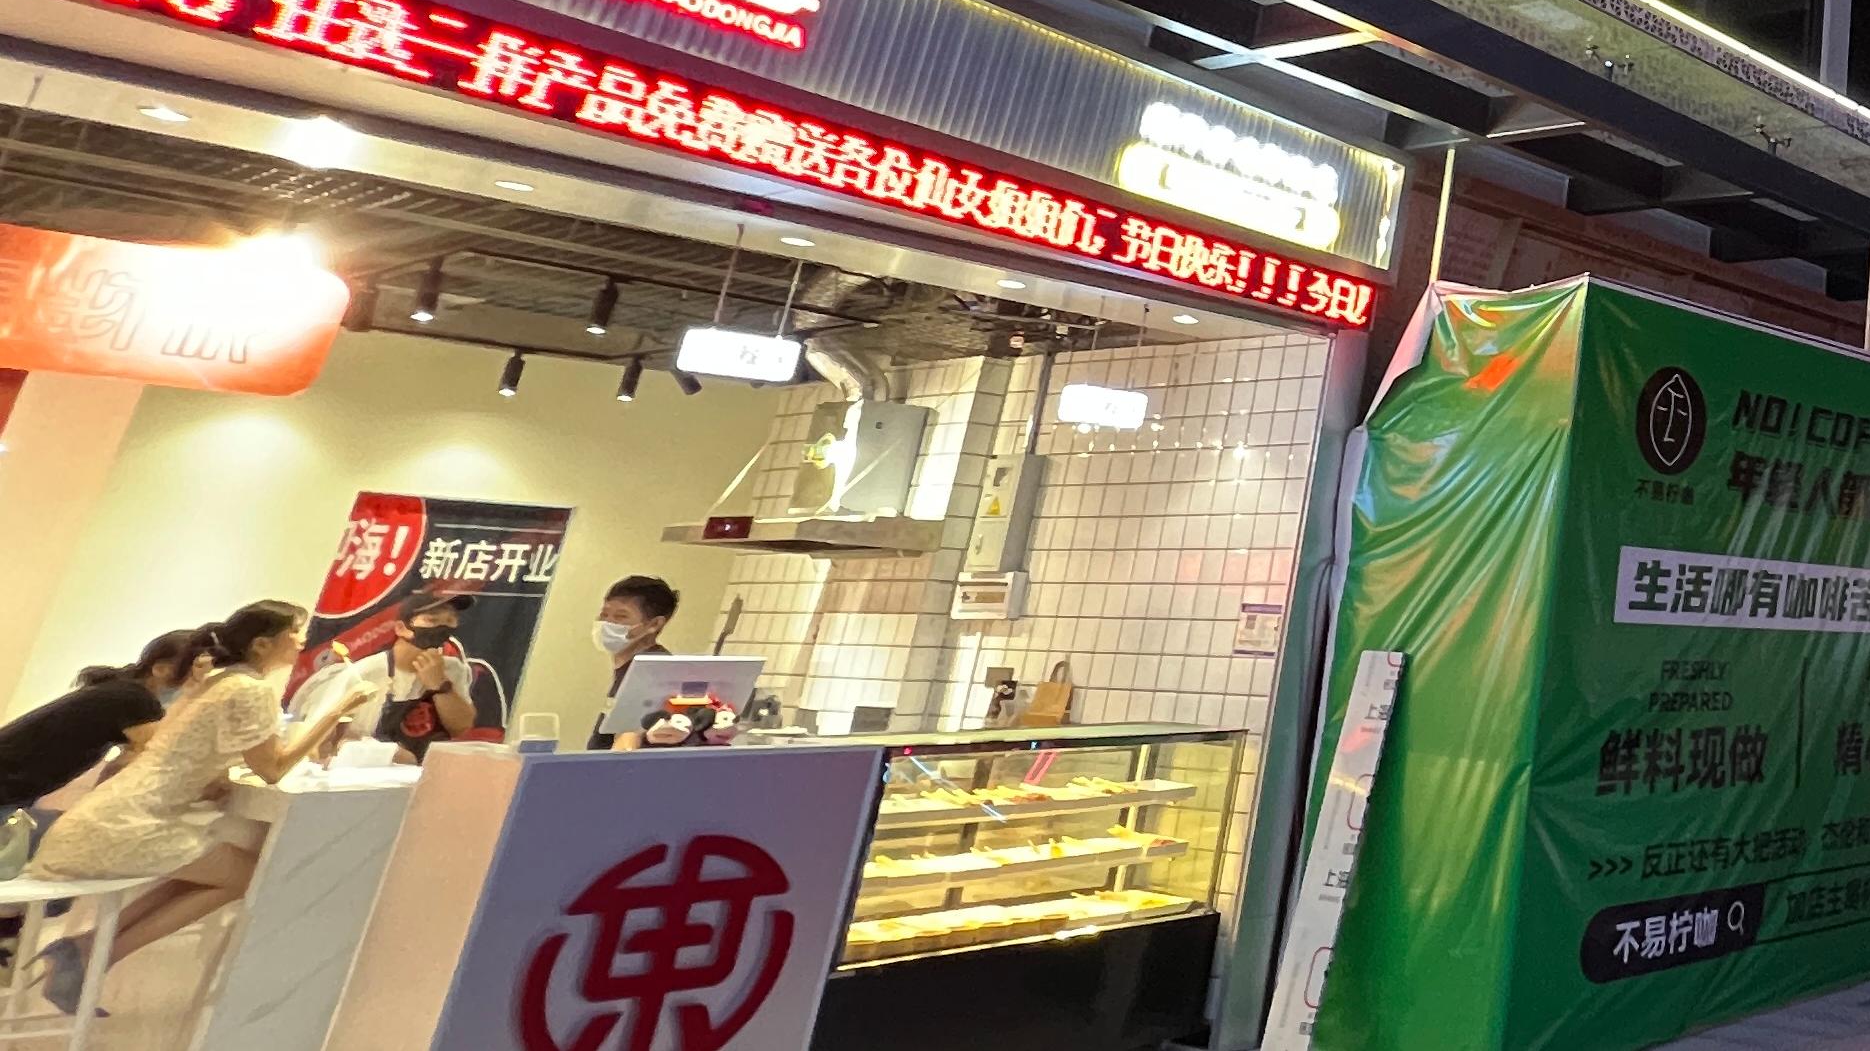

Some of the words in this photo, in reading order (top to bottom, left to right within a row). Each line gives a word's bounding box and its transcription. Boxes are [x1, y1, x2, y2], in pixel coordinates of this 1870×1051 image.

[418, 537, 561, 584] 新店开业
[1612, 904, 1720, 965] 不易柠咖
